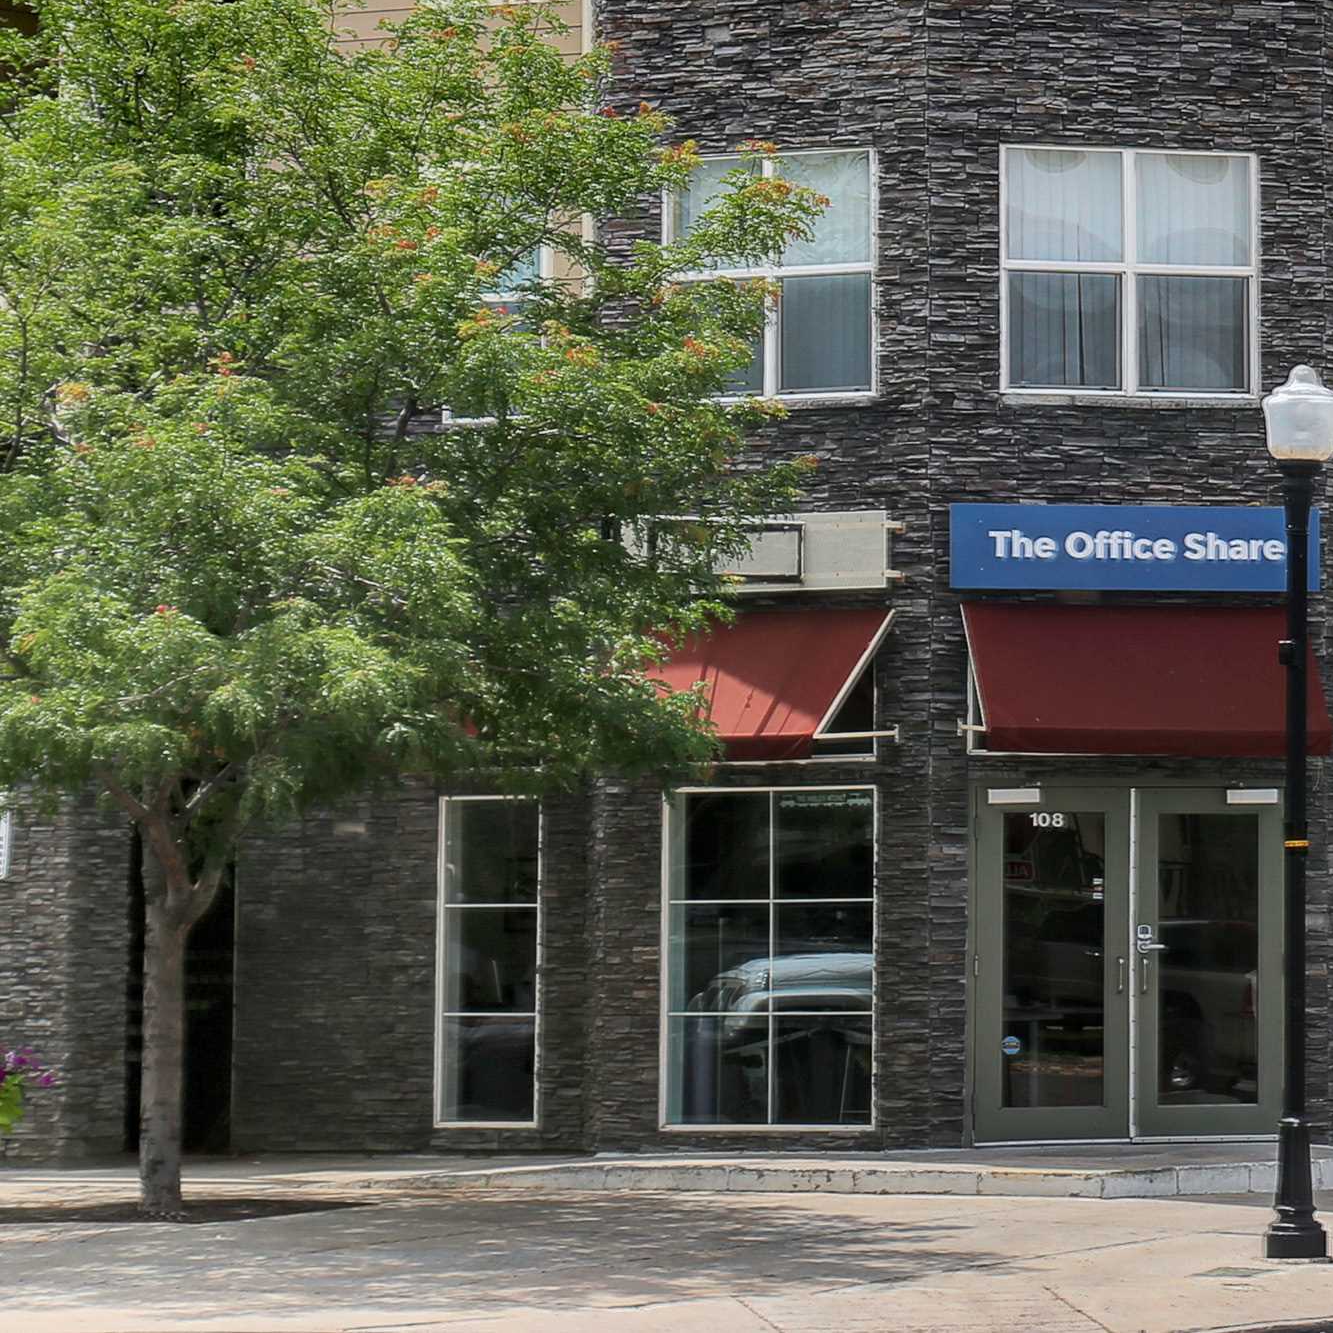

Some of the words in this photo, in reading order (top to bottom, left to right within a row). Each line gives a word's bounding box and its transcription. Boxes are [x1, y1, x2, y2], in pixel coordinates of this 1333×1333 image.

[988, 530, 1056, 559] The
[1065, 530, 1175, 560] Office
[1183, 532, 1286, 561] Share
[1029, 812, 1064, 827] 108
